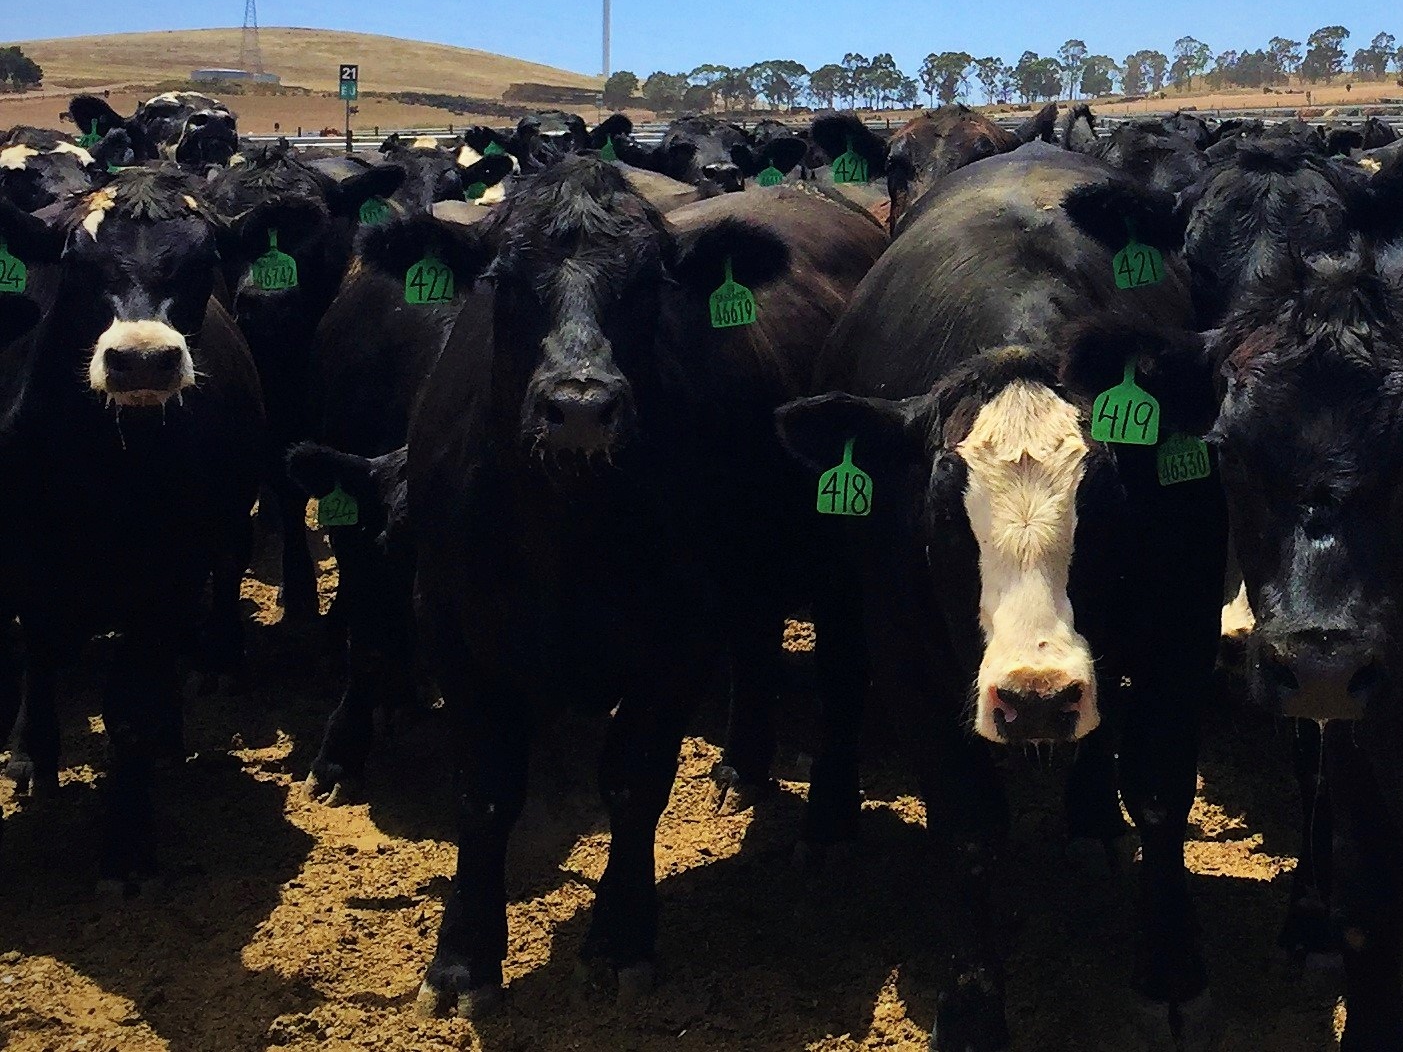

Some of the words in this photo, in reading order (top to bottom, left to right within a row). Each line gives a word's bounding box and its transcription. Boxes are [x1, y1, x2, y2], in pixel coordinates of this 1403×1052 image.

[342, 67, 356, 80] 21
[410, 266, 453, 301] 422
[1118, 251, 1157, 286] 421
[715, 299, 752, 325] 46619
[1098, 395, 1154, 439] 419
[1162, 450, 1207, 482] 46330
[821, 472, 868, 514] 418
